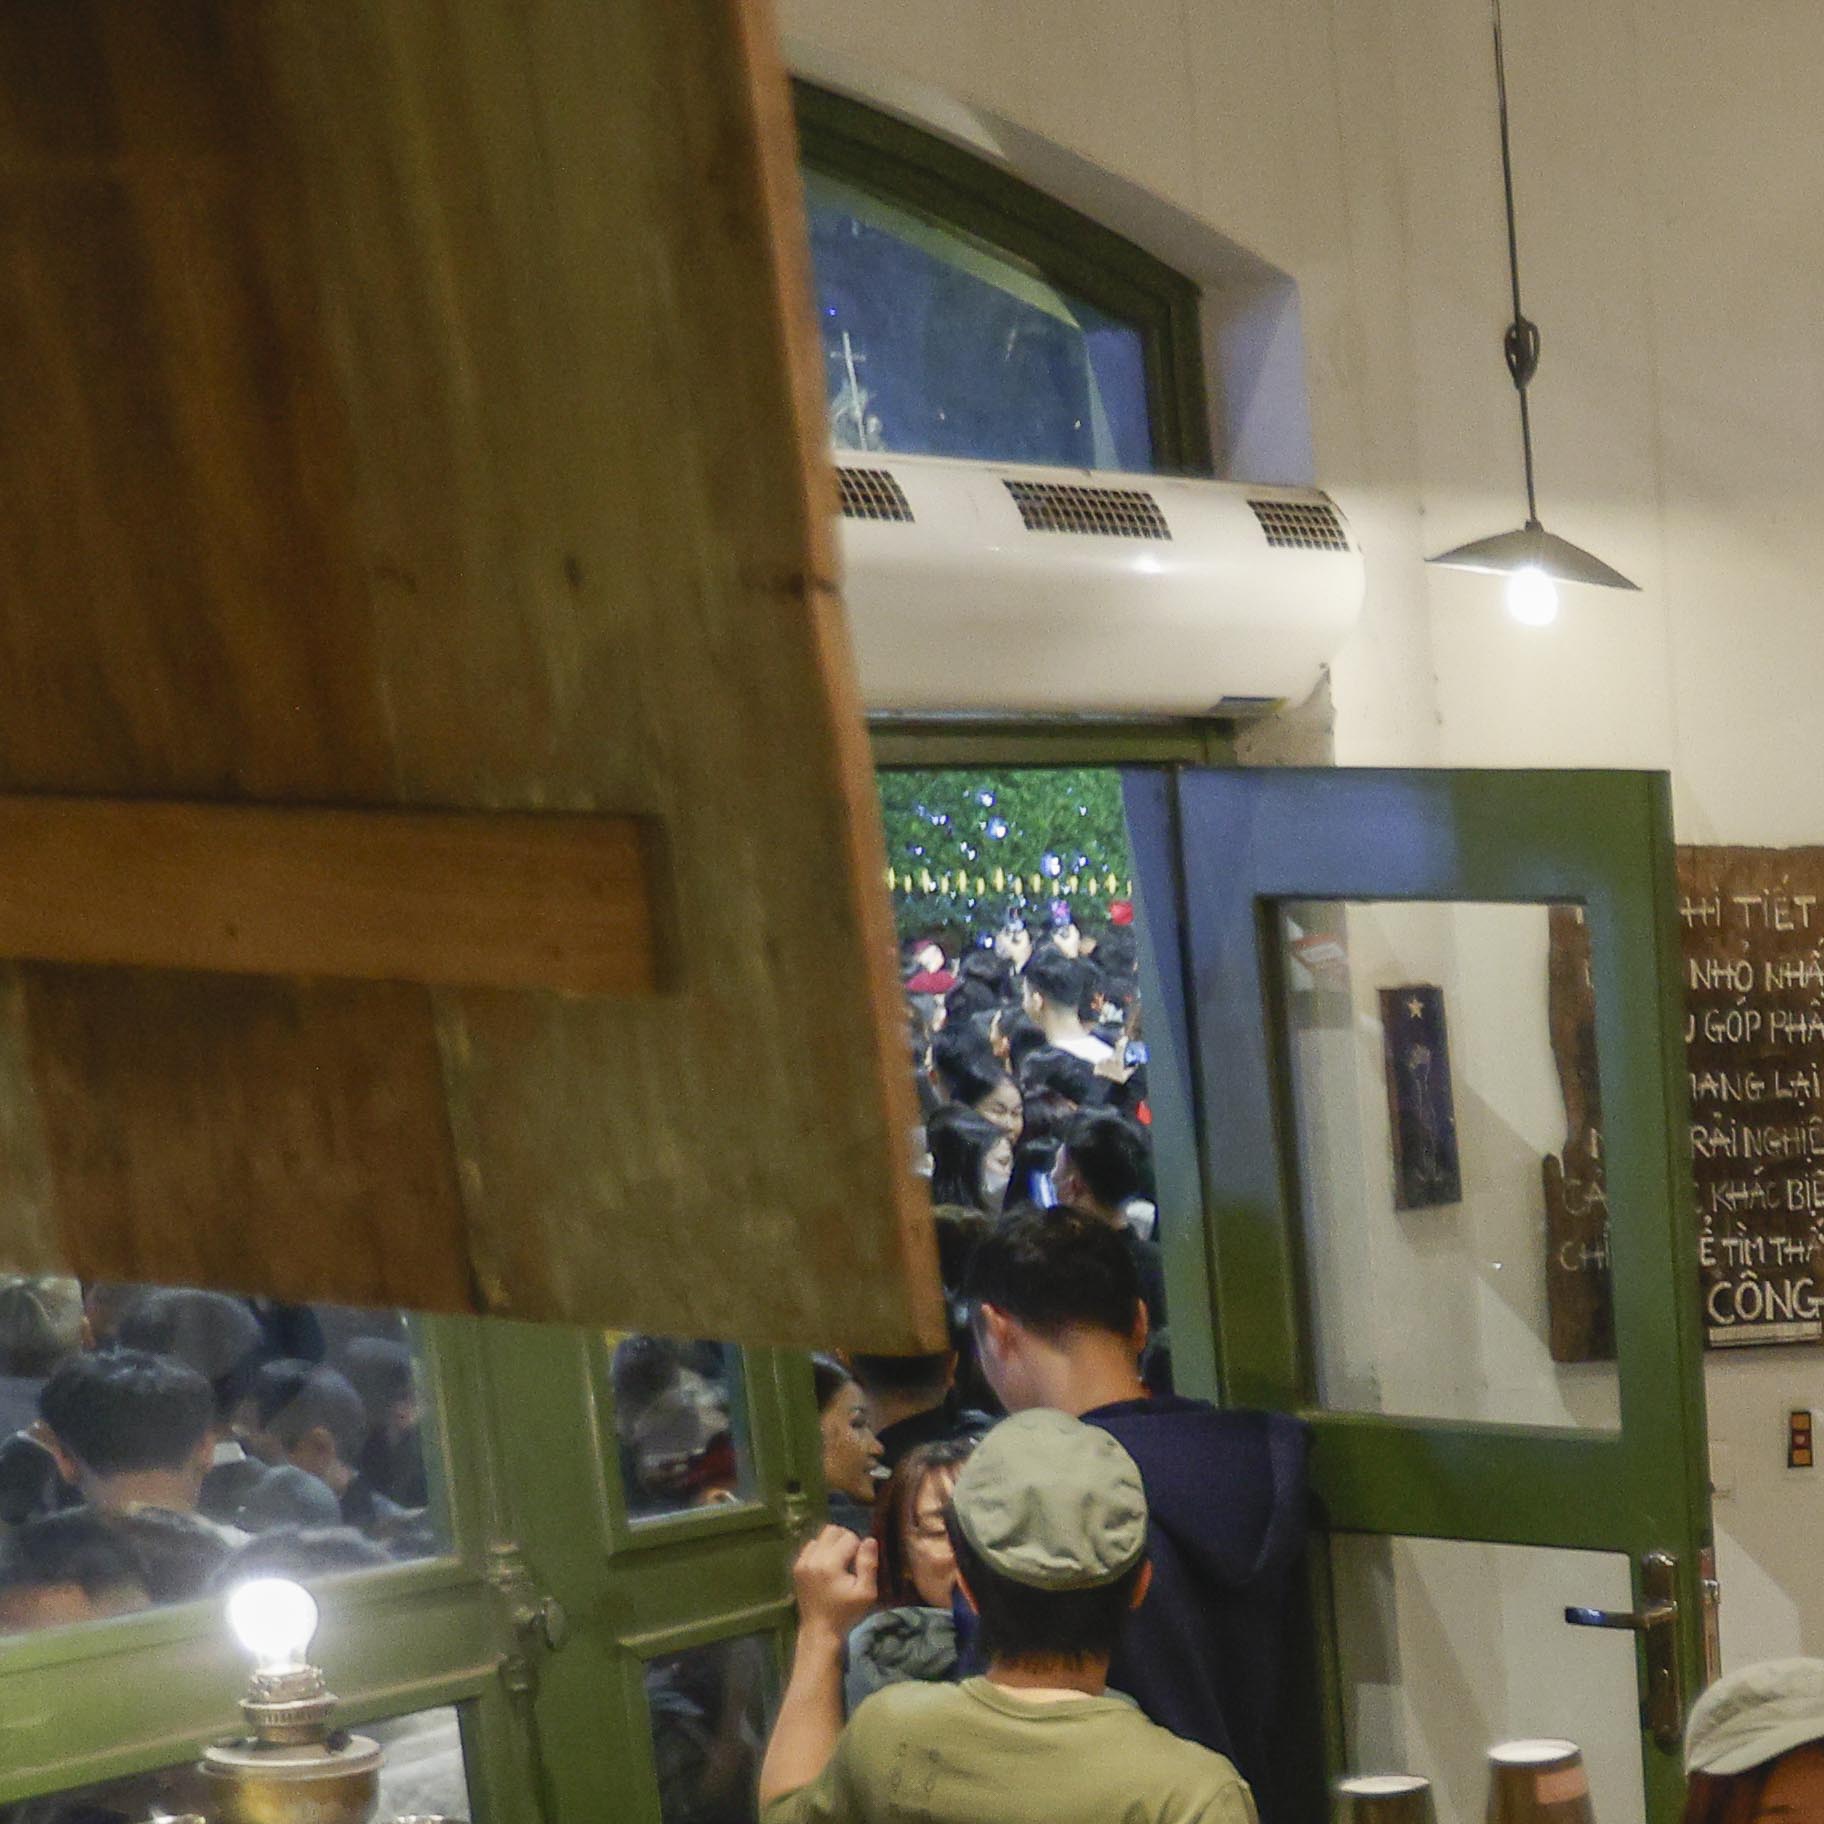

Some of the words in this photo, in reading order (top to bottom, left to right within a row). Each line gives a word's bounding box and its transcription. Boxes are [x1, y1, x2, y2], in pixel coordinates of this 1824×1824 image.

[1732, 873, 1817, 931] TIẾT
[1689, 939, 1754, 993] NHỎ
[1704, 996, 1762, 1044] GÓP
[1774, 1061, 1822, 1107] LẠI
[1711, 1166, 1782, 1213] KHÁC
